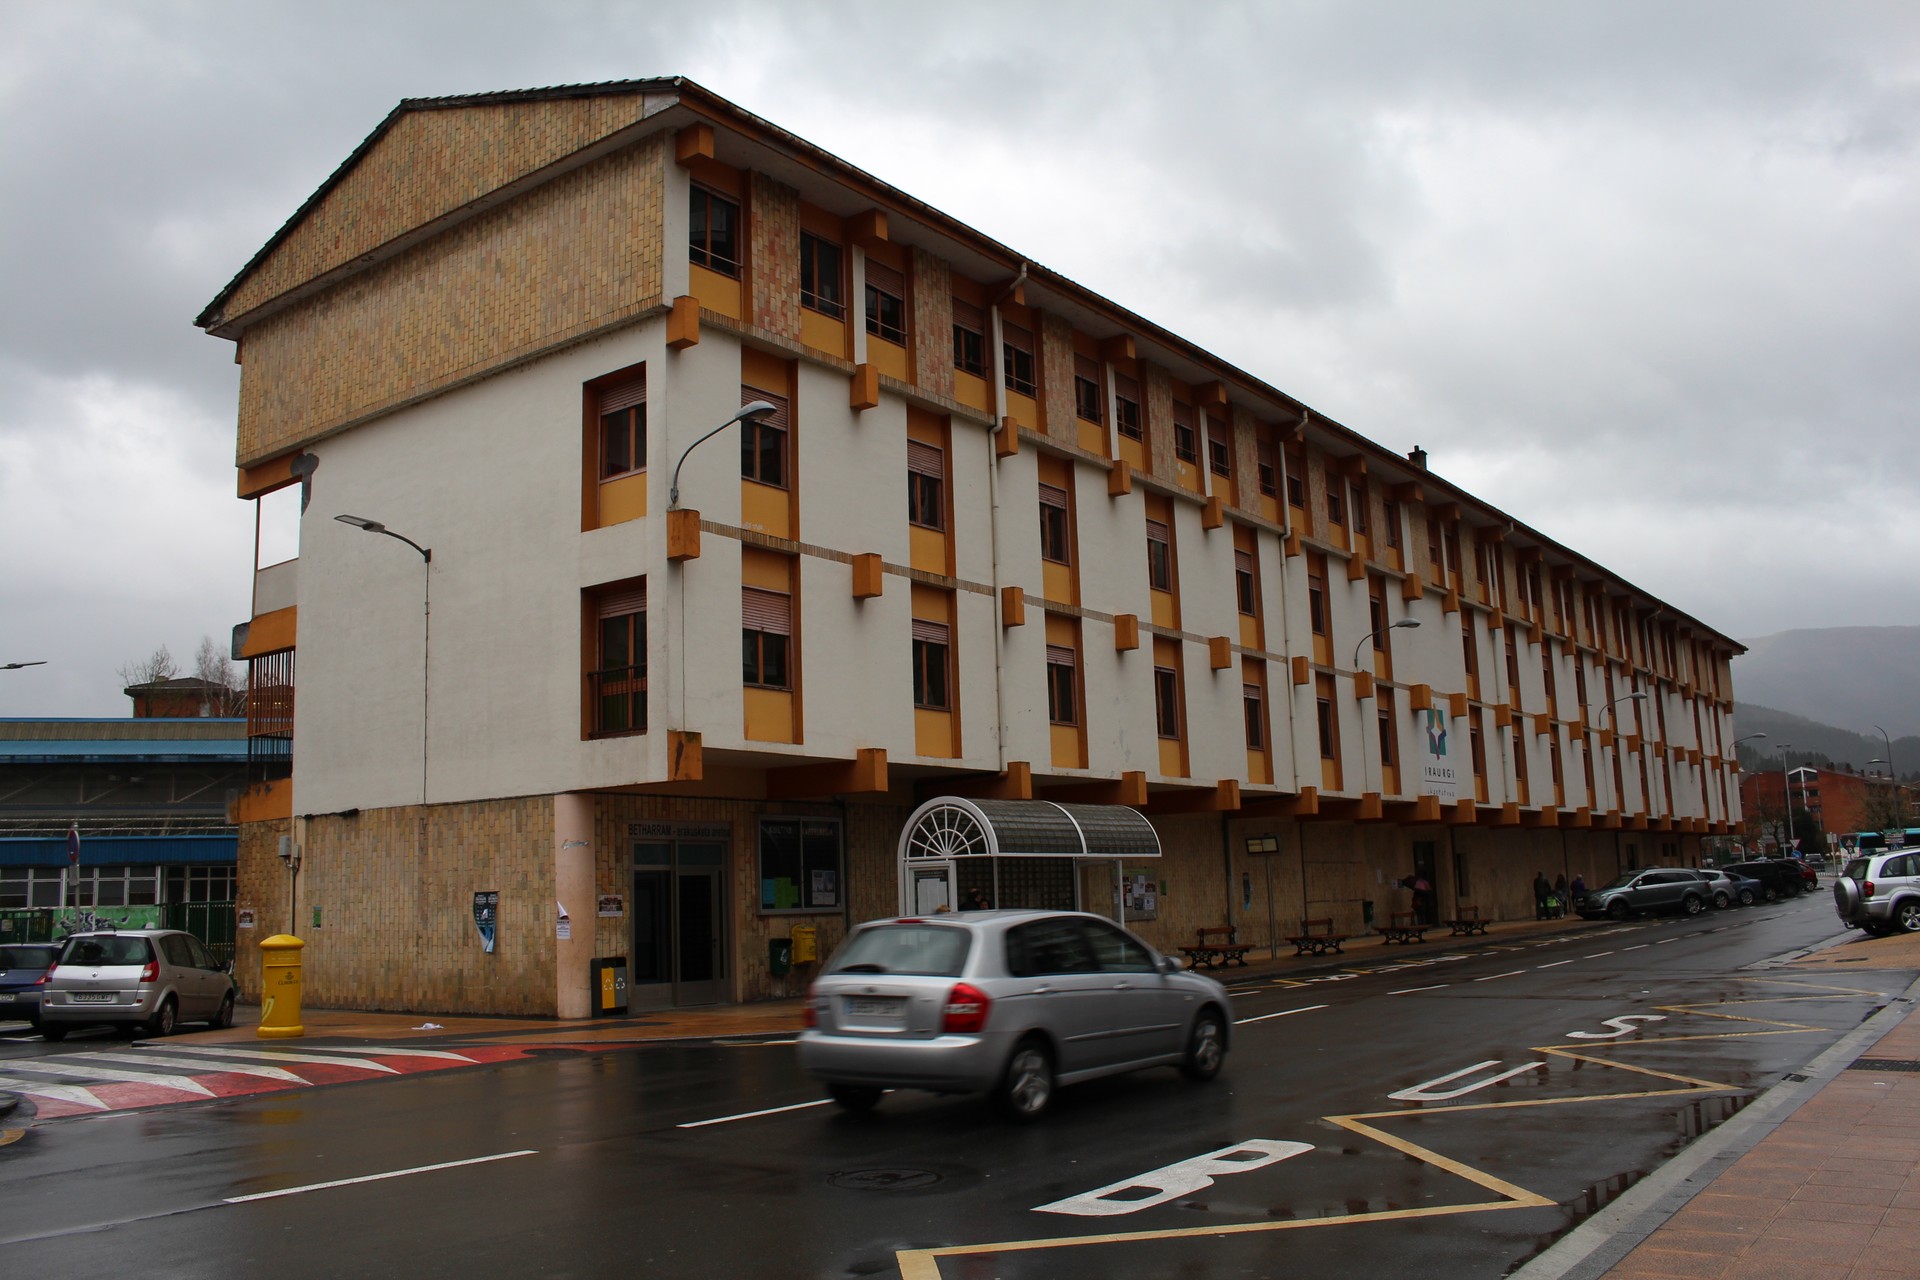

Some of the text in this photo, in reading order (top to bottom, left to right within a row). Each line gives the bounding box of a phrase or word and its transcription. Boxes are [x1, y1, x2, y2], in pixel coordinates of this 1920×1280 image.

[1424, 766, 1455, 778] IRAURGI
[628, 823, 671, 836] BETHARRAM
[1030, 1014, 1667, 1216] BUS
